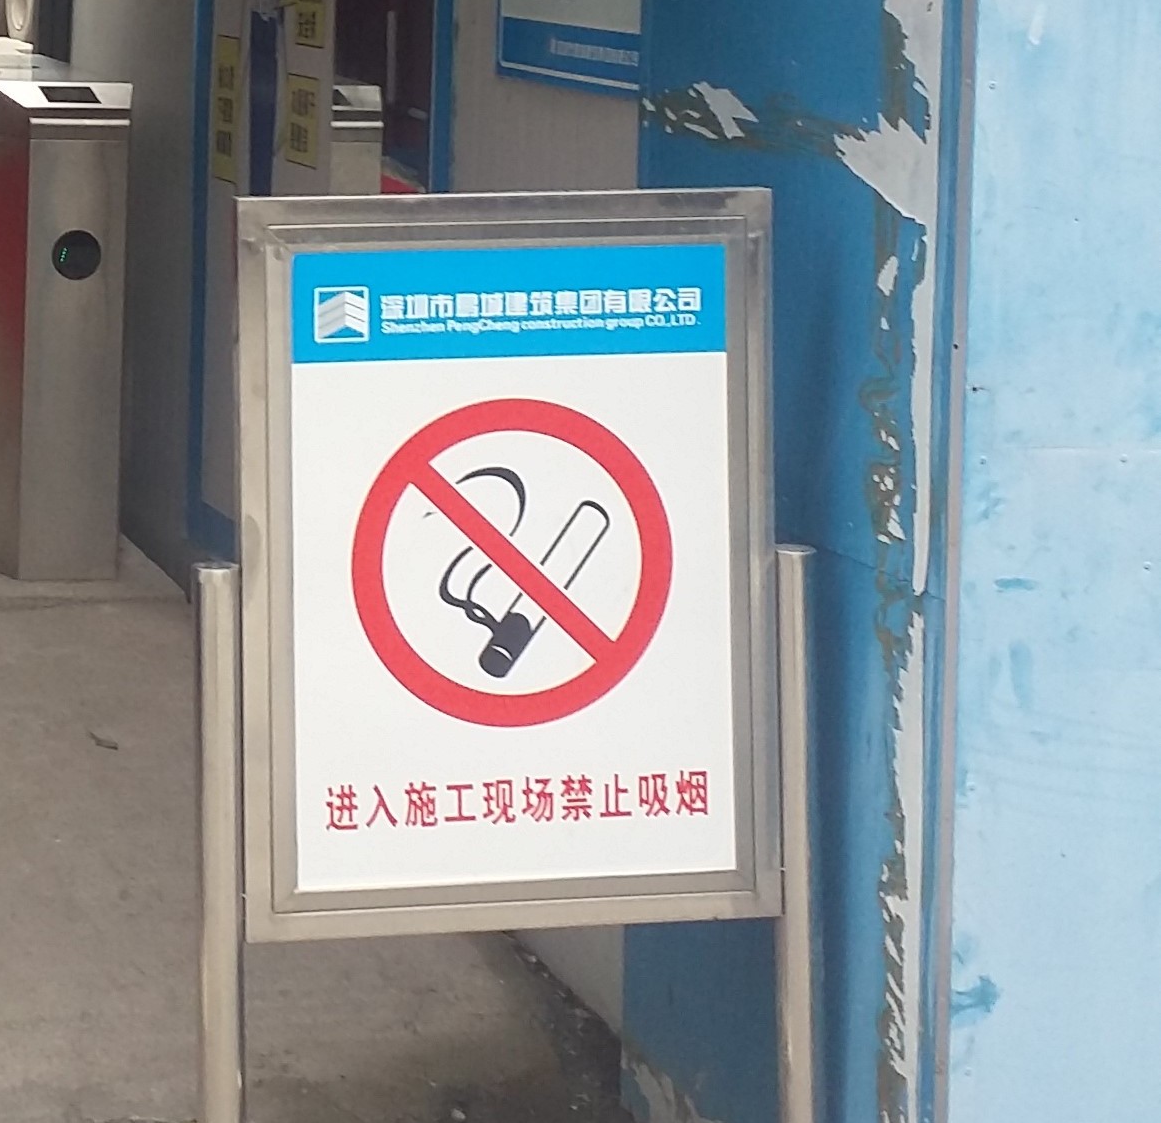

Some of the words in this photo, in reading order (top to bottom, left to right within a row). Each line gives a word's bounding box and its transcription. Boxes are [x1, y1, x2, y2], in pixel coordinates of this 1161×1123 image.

[380, 287, 702, 319] 深圳市鹏城建筑集团有限公司
[380, 320, 446, 334] Shenzhen
[325, 770, 710, 831] 进入施工现场禁止吸烟
